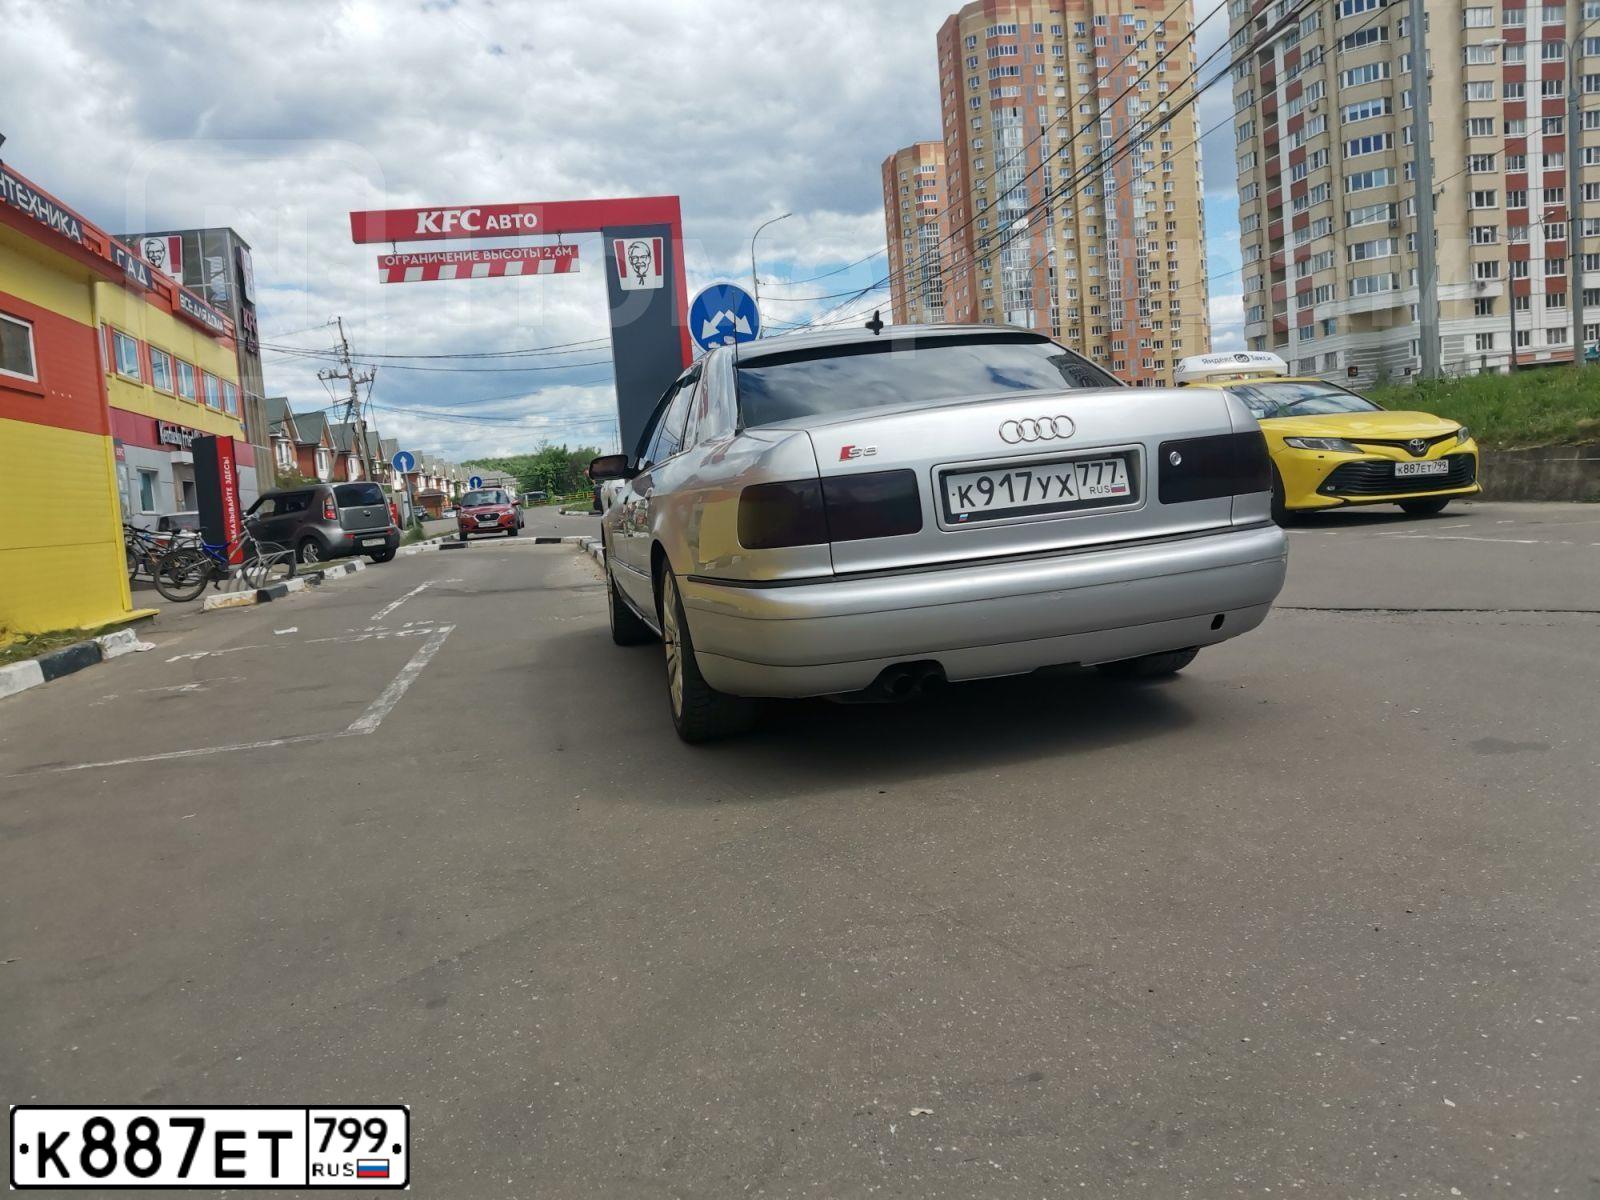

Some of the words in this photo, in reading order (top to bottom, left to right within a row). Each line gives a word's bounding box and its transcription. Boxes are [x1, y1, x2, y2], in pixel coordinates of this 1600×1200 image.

[415, 208, 480, 234] KFC
[486, 213, 537, 230] АВТО
[384, 249, 479, 266] ОГРАНИЧЕНИЕ
[483, 247, 540, 260] ВЫСОТЫ
[544, 246, 572, 259] 2,6М
[1201, 357, 1232, 365] Яндекс
[957, 471, 1074, 508] К917УХ
[1076, 461, 1118, 486] 777
[1089, 484, 1111, 494] RUS
